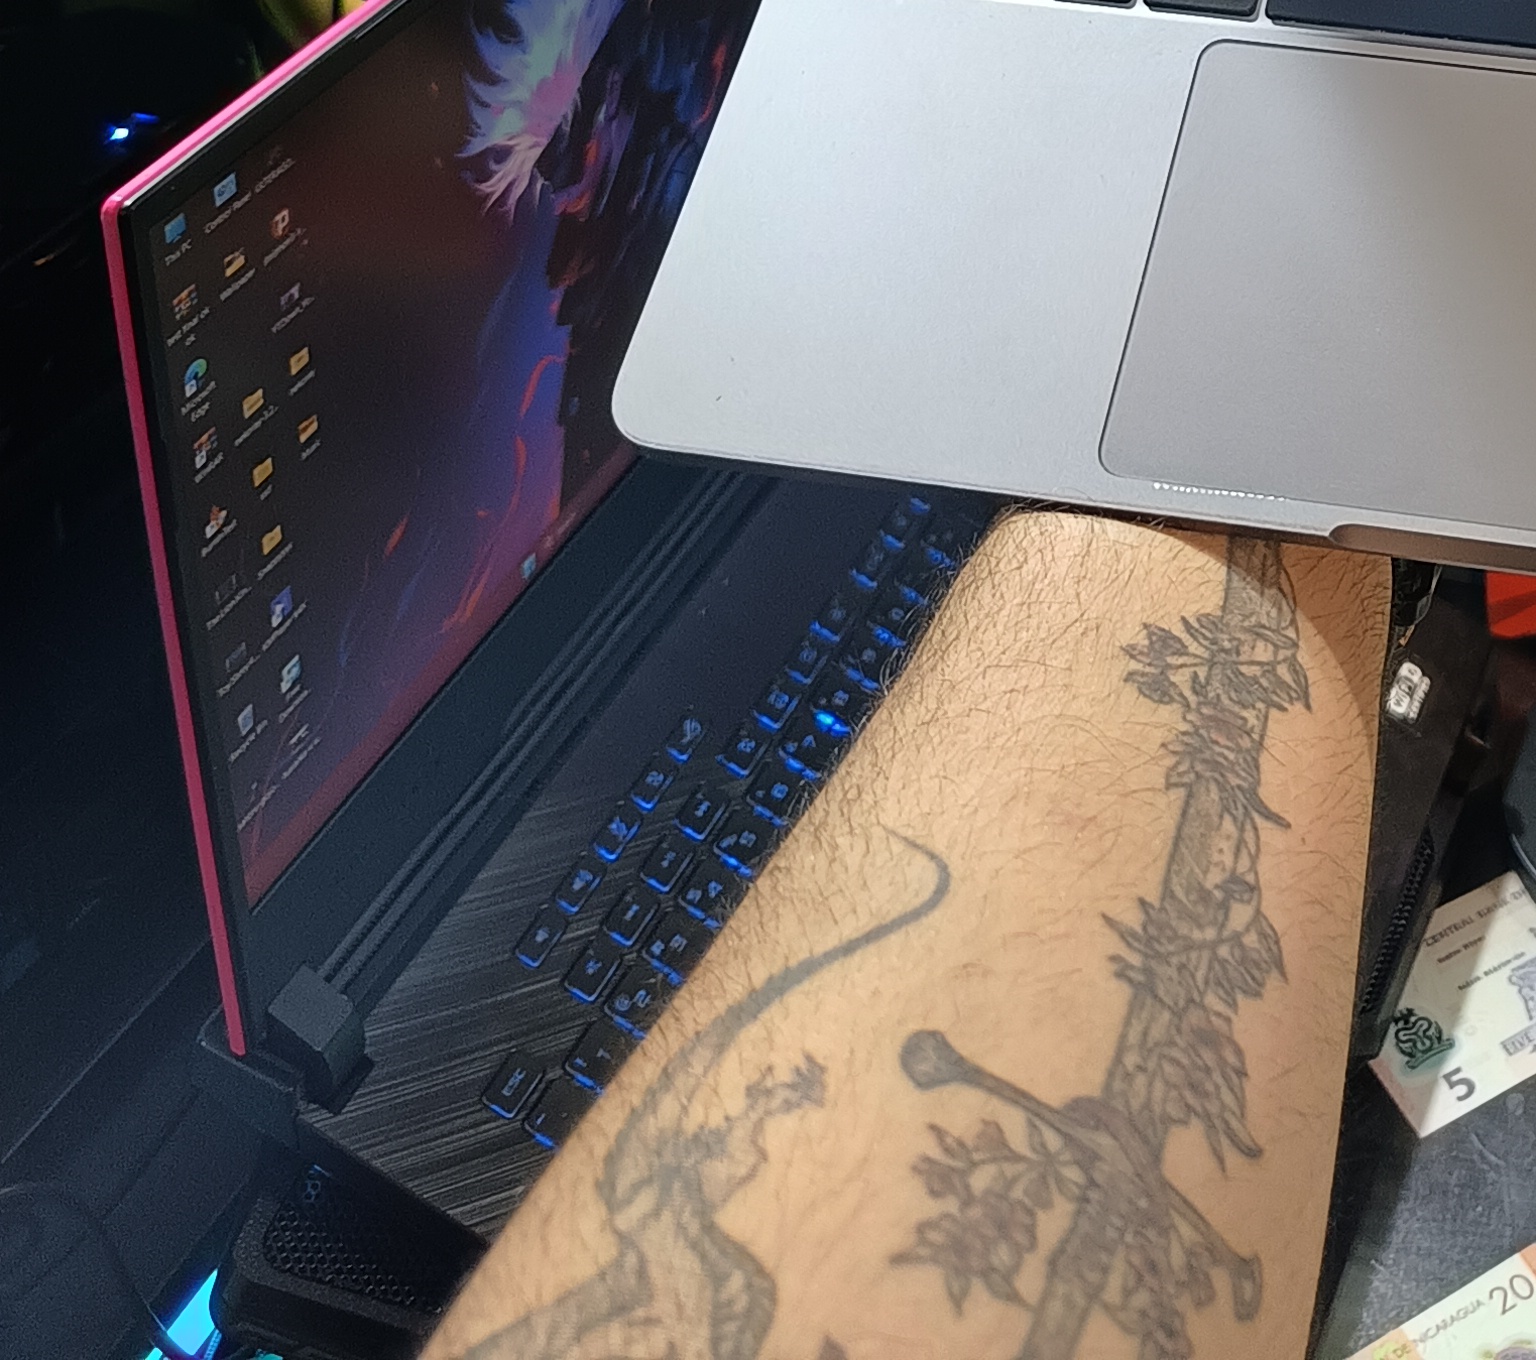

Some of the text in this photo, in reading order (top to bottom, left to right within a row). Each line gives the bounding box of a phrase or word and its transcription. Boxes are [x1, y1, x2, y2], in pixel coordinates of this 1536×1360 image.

[1442, 1066, 1476, 1102] 5
[1489, 1273, 1535, 1316] 20
[1412, 1298, 1487, 1346] NICARAGUA
